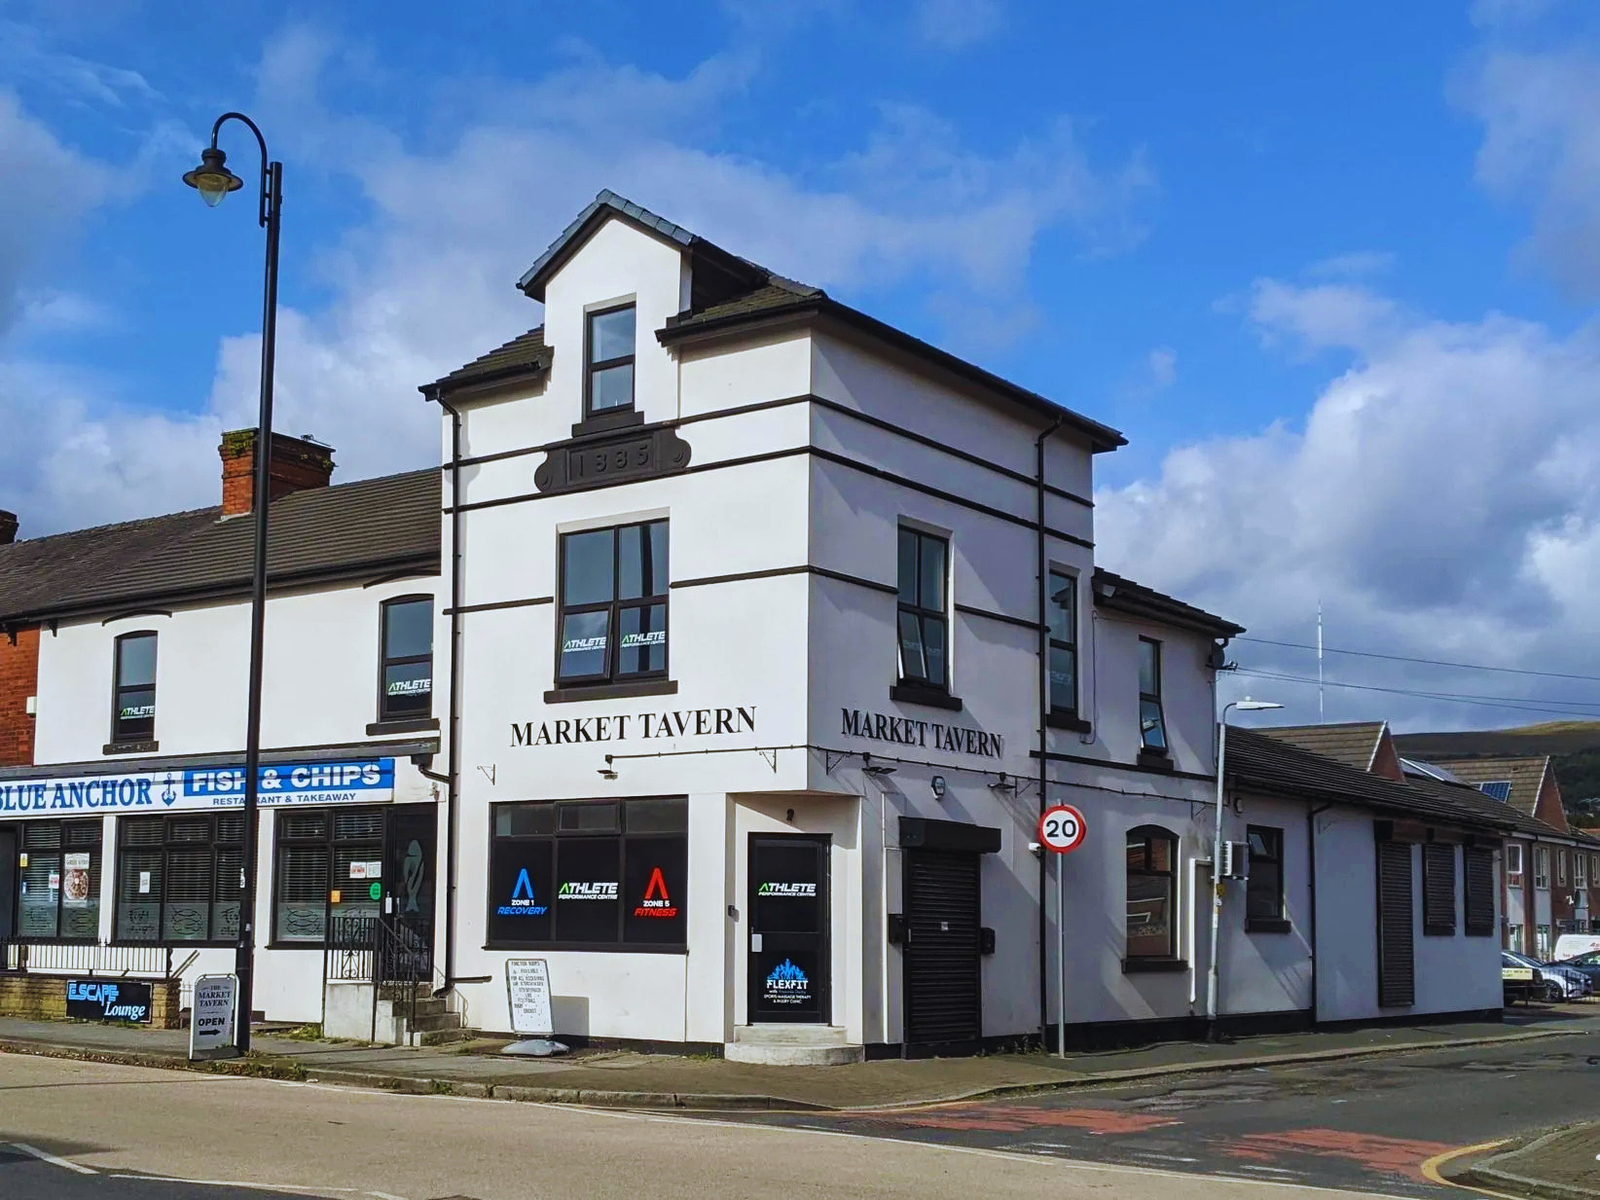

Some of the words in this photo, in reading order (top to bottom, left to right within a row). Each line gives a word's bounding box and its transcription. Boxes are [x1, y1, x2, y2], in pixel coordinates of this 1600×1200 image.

[579, 443, 649, 477] 1885
[564, 636, 607, 648] ATHLETE
[620, 631, 665, 644] ATHLETE
[388, 679, 431, 691] ATHLETE
[120, 705, 155, 716] ATHLETE
[510, 714, 631, 748] MARKET
[638, 705, 757, 739] TAVERN
[841, 707, 929, 747] MARKET
[931, 723, 1003, 759] TAVERN
[261, 768, 283, 790] &
[291, 764, 381, 788] CHIPS
[0, 783, 47, 811] LUE
[50, 778, 153, 809] ANCHOR
[284, 794, 293, 803] &
[296, 792, 356, 802] TAKEAWAY
[1046, 820, 1076, 837] 20
[559, 882, 618, 894] ATHLETE
[759, 883, 817, 892] ATHLETE
[498, 906, 548, 915] RECOVERY
[634, 908, 677, 917] FITNESS
[766, 979, 809, 990] FLEXFIT
[68, 983, 119, 1006] ESCAPE
[199, 991, 231, 999] MARKET
[104, 1002, 146, 1020] Lounge
[198, 1017, 226, 1026] OPEN
